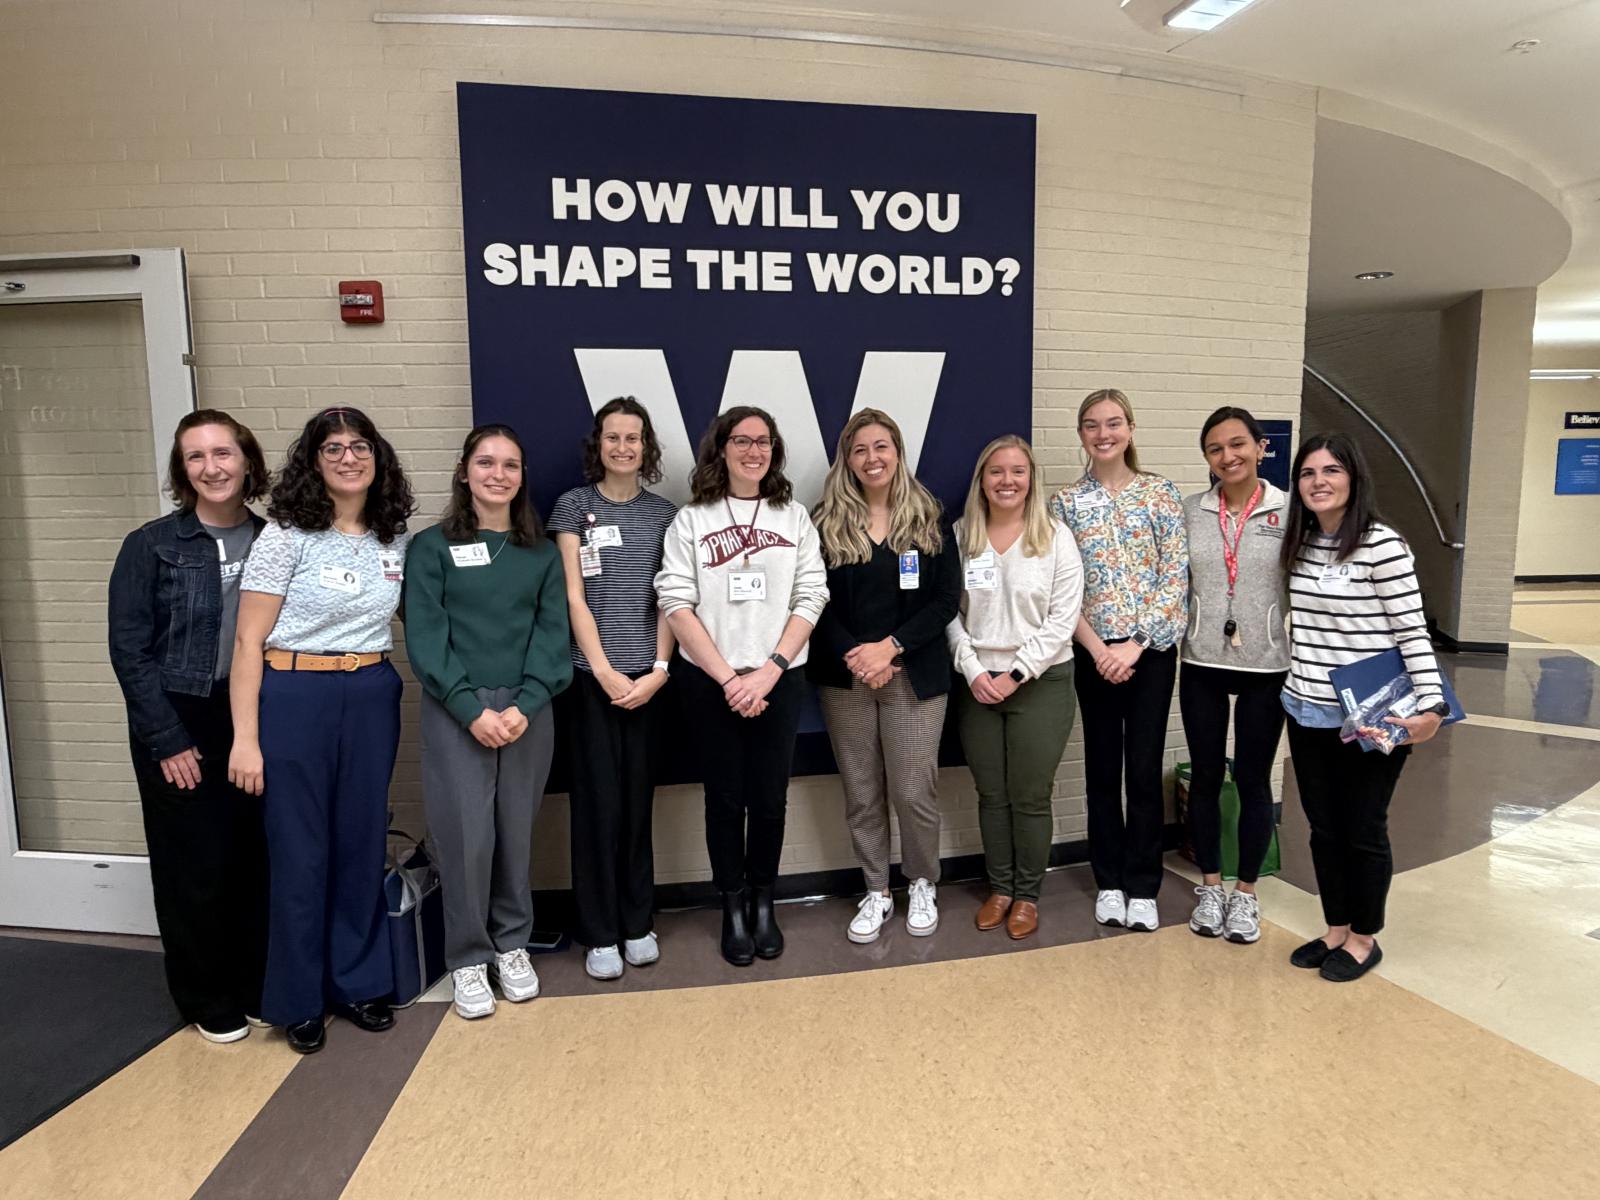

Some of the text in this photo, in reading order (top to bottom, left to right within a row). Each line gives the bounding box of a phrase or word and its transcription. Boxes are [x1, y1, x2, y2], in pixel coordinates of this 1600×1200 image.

[551, 177, 960, 233] HOW WILL YOU
[483, 242, 1021, 297] SHAPE THE WORLD?
[574, 348, 946, 510] W
[1570, 415, 1600, 424] Believ
